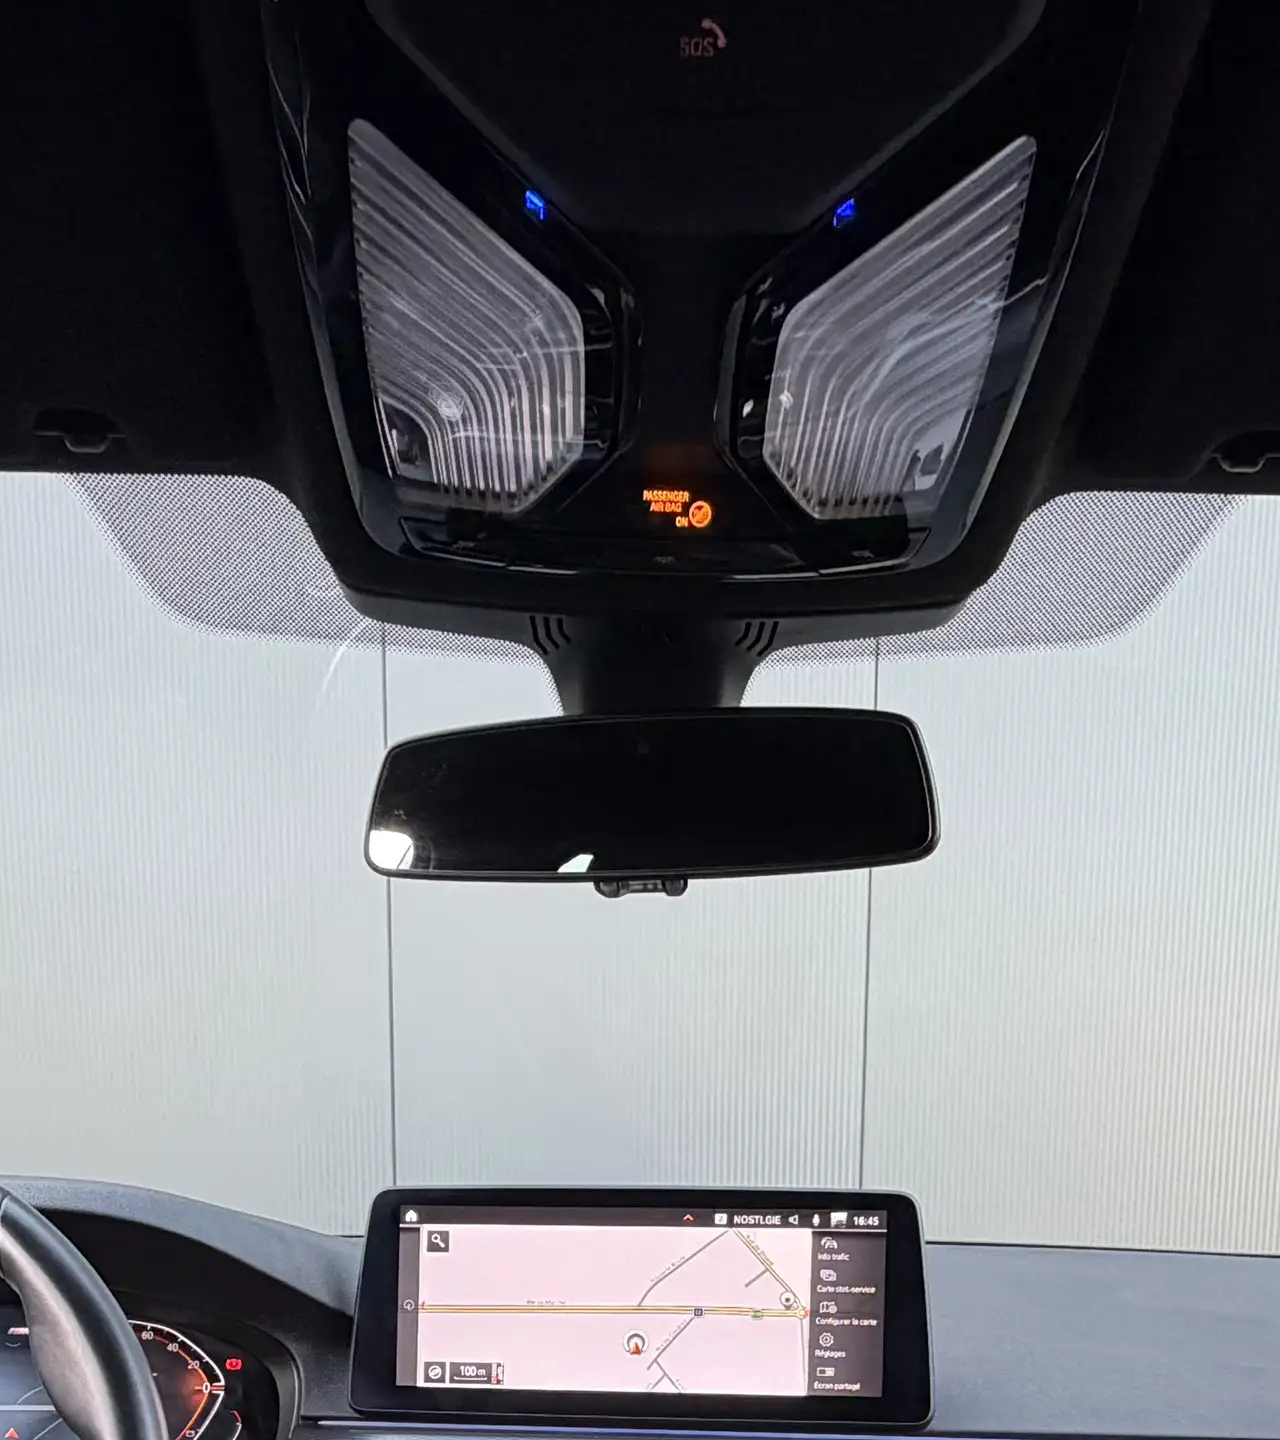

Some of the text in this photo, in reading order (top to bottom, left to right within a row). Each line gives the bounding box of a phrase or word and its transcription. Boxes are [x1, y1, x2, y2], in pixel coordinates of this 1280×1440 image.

[680, 38, 714, 57] SOS
[643, 489, 689, 502] PASSENGER
[675, 516, 688, 527] ON
[733, 1215, 782, 1225] NOSTLGIE
[853, 1216, 880, 1226] 16:45
[817, 1252, 850, 1261] Info trafic
[816, 1284, 835, 1293] Carte
[815, 1317, 851, 1327] Configurer
[851, 1317, 859, 1326] la
[141, 1331, 154, 1340] 60
[166, 1343, 179, 1352] 40
[814, 1349, 846, 1358] Réglages
[187, 1361, 200, 1369] 20
[460, 1366, 477, 1376] 100
[202, 1382, 211, 1393] 0
[813, 1380, 861, 1391] Écran partagé
